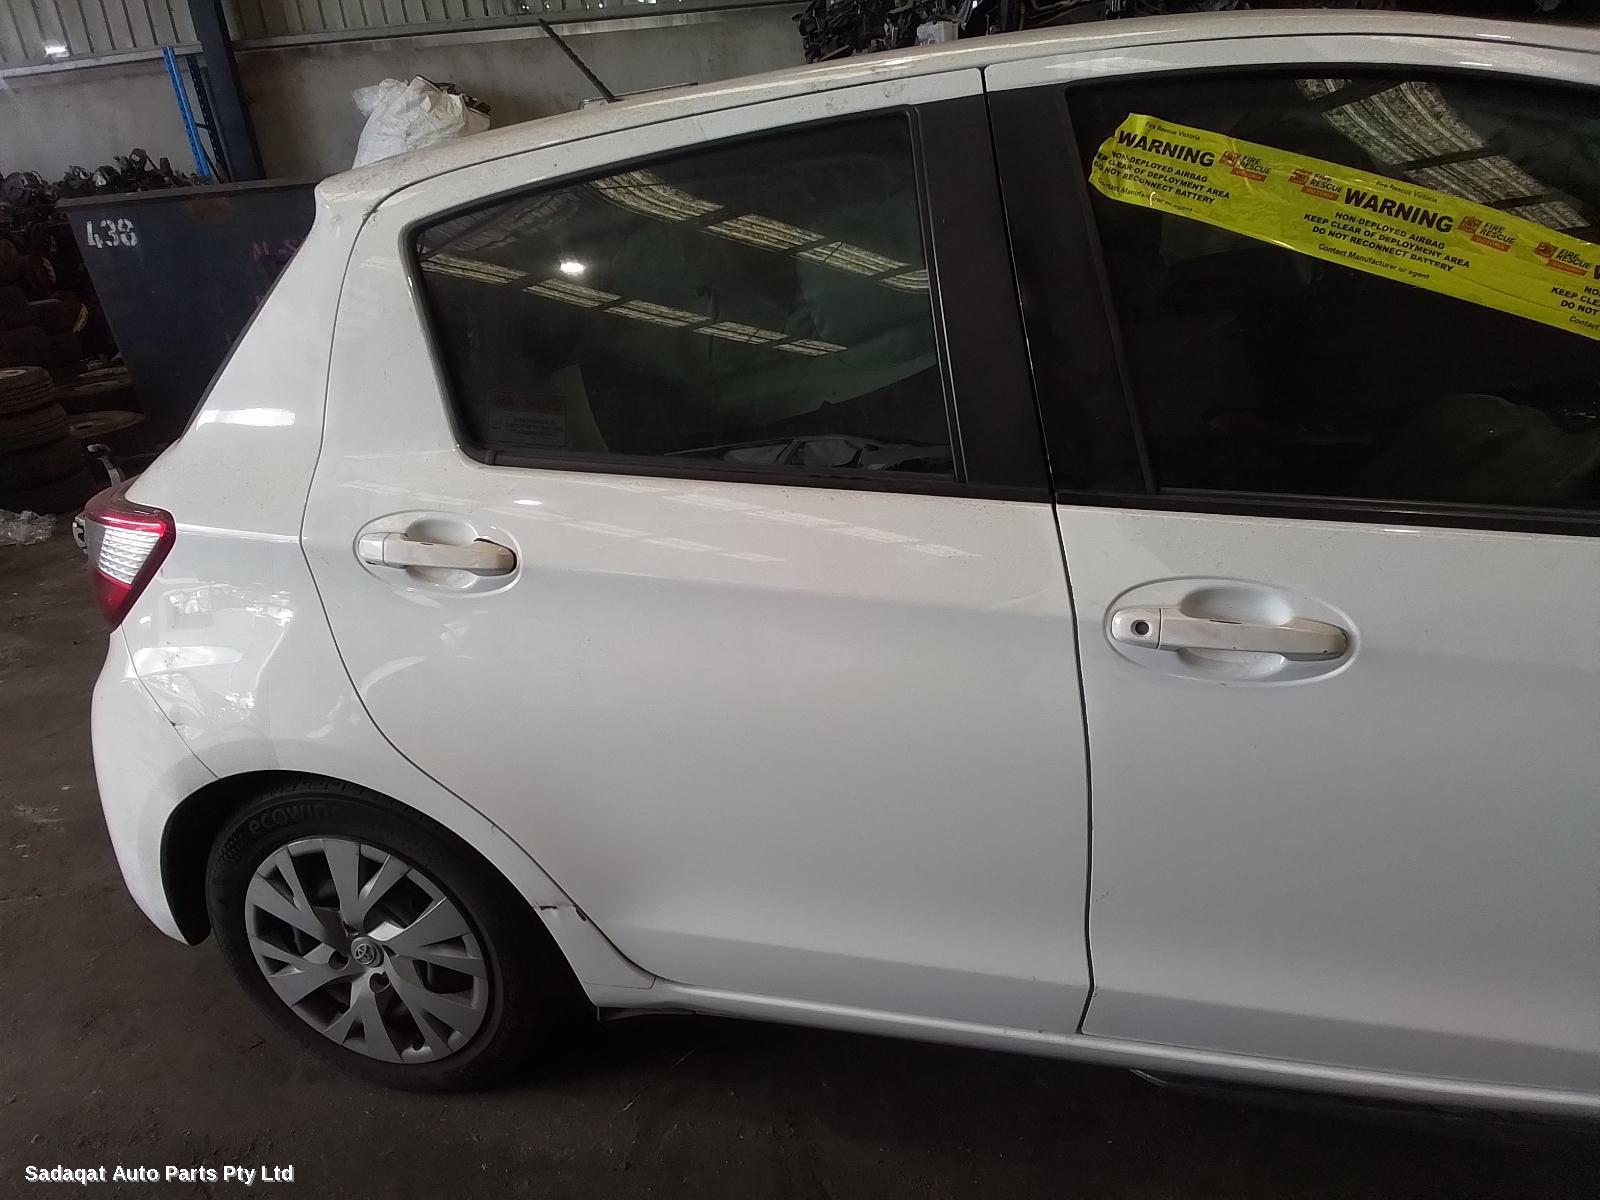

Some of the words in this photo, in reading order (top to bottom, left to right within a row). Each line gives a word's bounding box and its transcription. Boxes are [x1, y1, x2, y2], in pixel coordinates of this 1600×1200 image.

[1178, 130, 1201, 141] Victoria
[1117, 130, 1216, 168] WARNING
[1239, 160, 1272, 175] RESCUE
[1242, 155, 1262, 165] FIRE
[1097, 177, 1120, 192] Contact
[1108, 160, 1133, 171] CLEAR
[1134, 167, 1146, 175] OF
[1148, 171, 1205, 193] DEPLOYMENT
[1206, 187, 1230, 200] AREA
[1175, 170, 1208, 183] AIRBAG
[1104, 166, 1122, 177] NOT
[1121, 173, 1174, 193] RECONNECT
[1175, 188, 1216, 204] BATTERY
[1309, 180, 1345, 193] RESCUE
[1389, 184, 1412, 196] Rescue
[1413, 189, 1438, 203] Victoria
[1343, 187, 1454, 233] WARNING
[86, 218, 138, 249] 438
[1335, 211, 1407, 238] NON-DEPLOYED
[1408, 233, 1446, 250] AIRBAG
[1484, 222, 1505, 233] FIRE
[1303, 213, 1329, 225] KEEP
[1331, 220, 1361, 235] CLEAR
[1363, 229, 1376, 238] OF
[1378, 234, 1442, 259] DEPLOYMENT
[1443, 254, 1470, 269] AREA
[1479, 228, 1516, 244] RESCUE
[1312, 225, 1327, 235] DO
[1328, 230, 1347, 241] NOT
[1350, 236, 1408, 258] RECONNECT
[1410, 252, 1454, 272] BATTERY
[1559, 248, 1581, 260] FIRE
[1318, 243, 1347, 258] Contact
[1348, 251, 1397, 271] Manufacturer
[1408, 269, 1430, 281] agent
[1555, 254, 1591, 270] RESCUE
[1551, 286, 1578, 299] KEEP
[1560, 300, 1575, 309] DO
[1577, 304, 1600, 316] NOT
